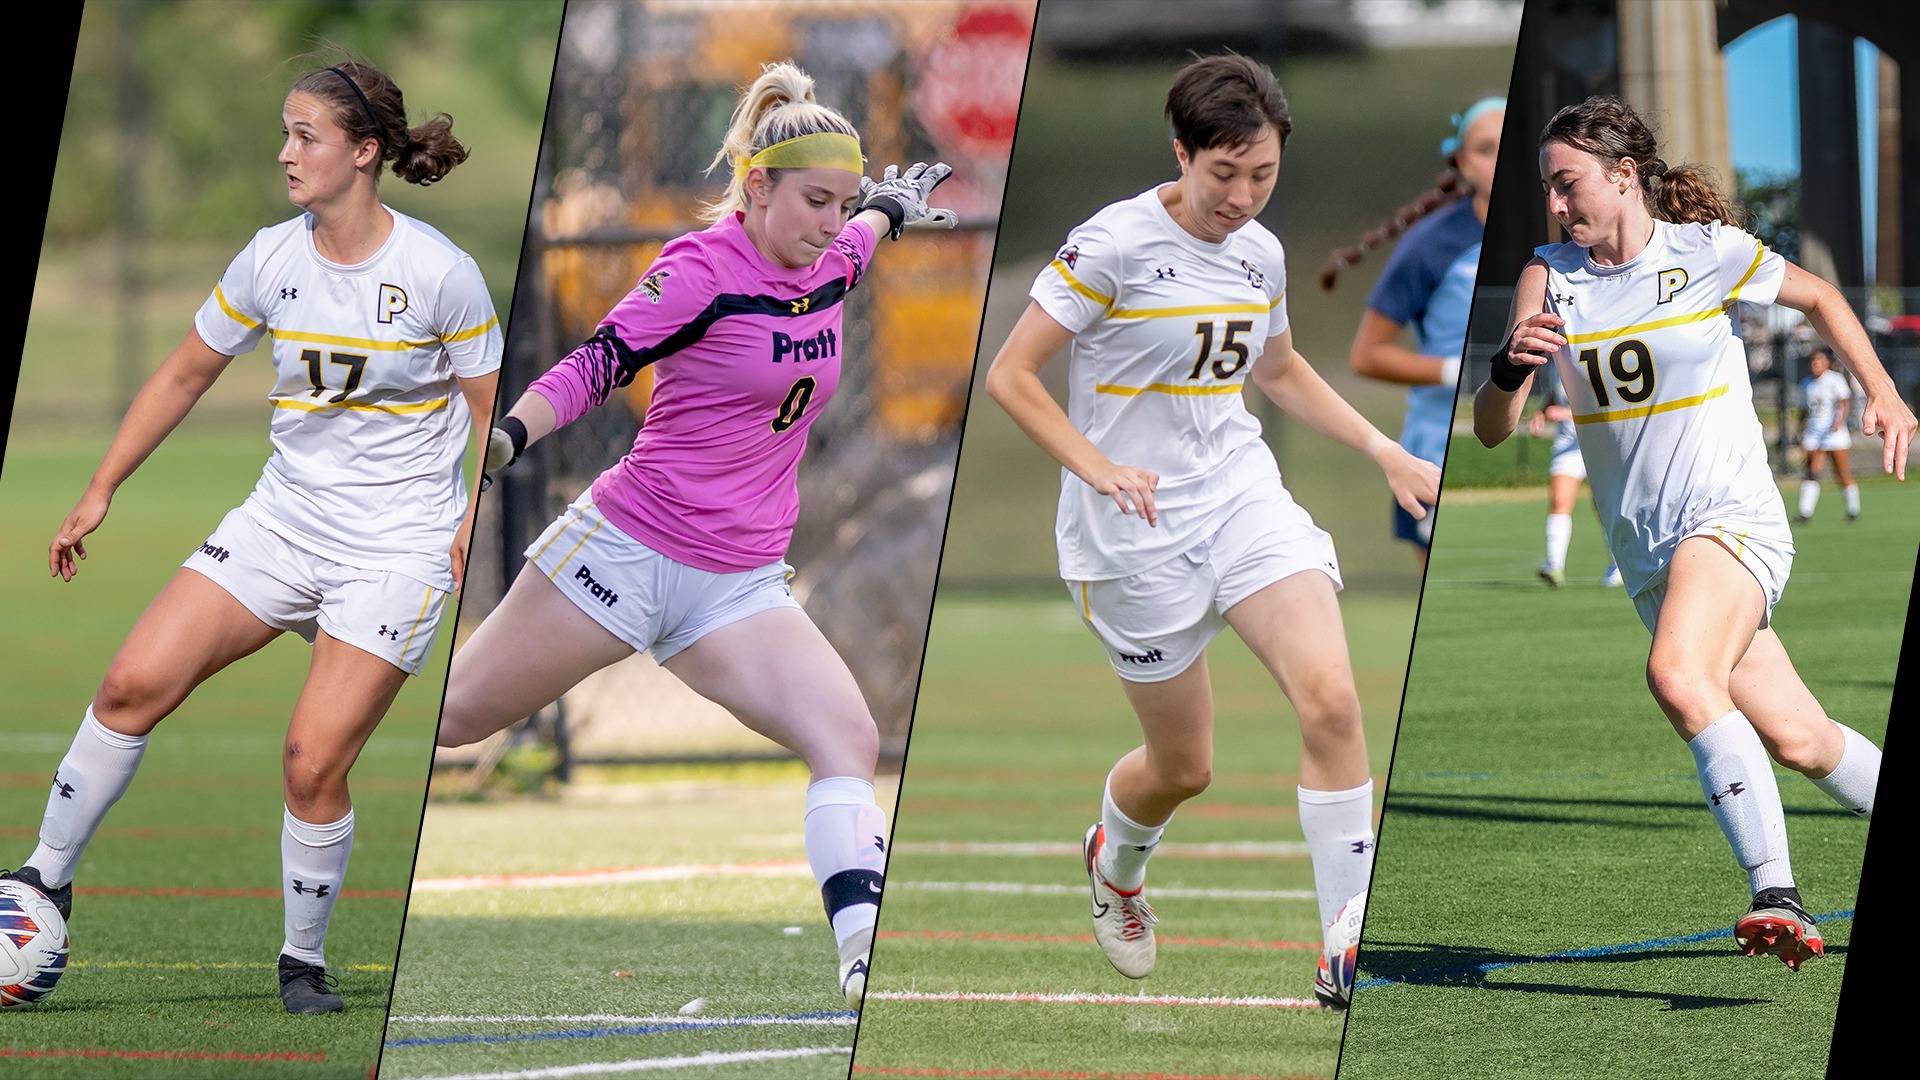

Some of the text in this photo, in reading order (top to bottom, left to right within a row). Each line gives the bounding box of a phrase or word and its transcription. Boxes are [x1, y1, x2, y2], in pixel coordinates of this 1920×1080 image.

[377, 283, 408, 324] P
[1657, 267, 1689, 305] P
[772, 328, 836, 363] Pratt
[1187, 320, 1253, 380] 15
[300, 348, 369, 404] 17
[1578, 338, 1656, 408] 19
[770, 376, 817, 434] 0
[196, 541, 230, 563] ratt
[574, 564, 619, 608] Pratt
